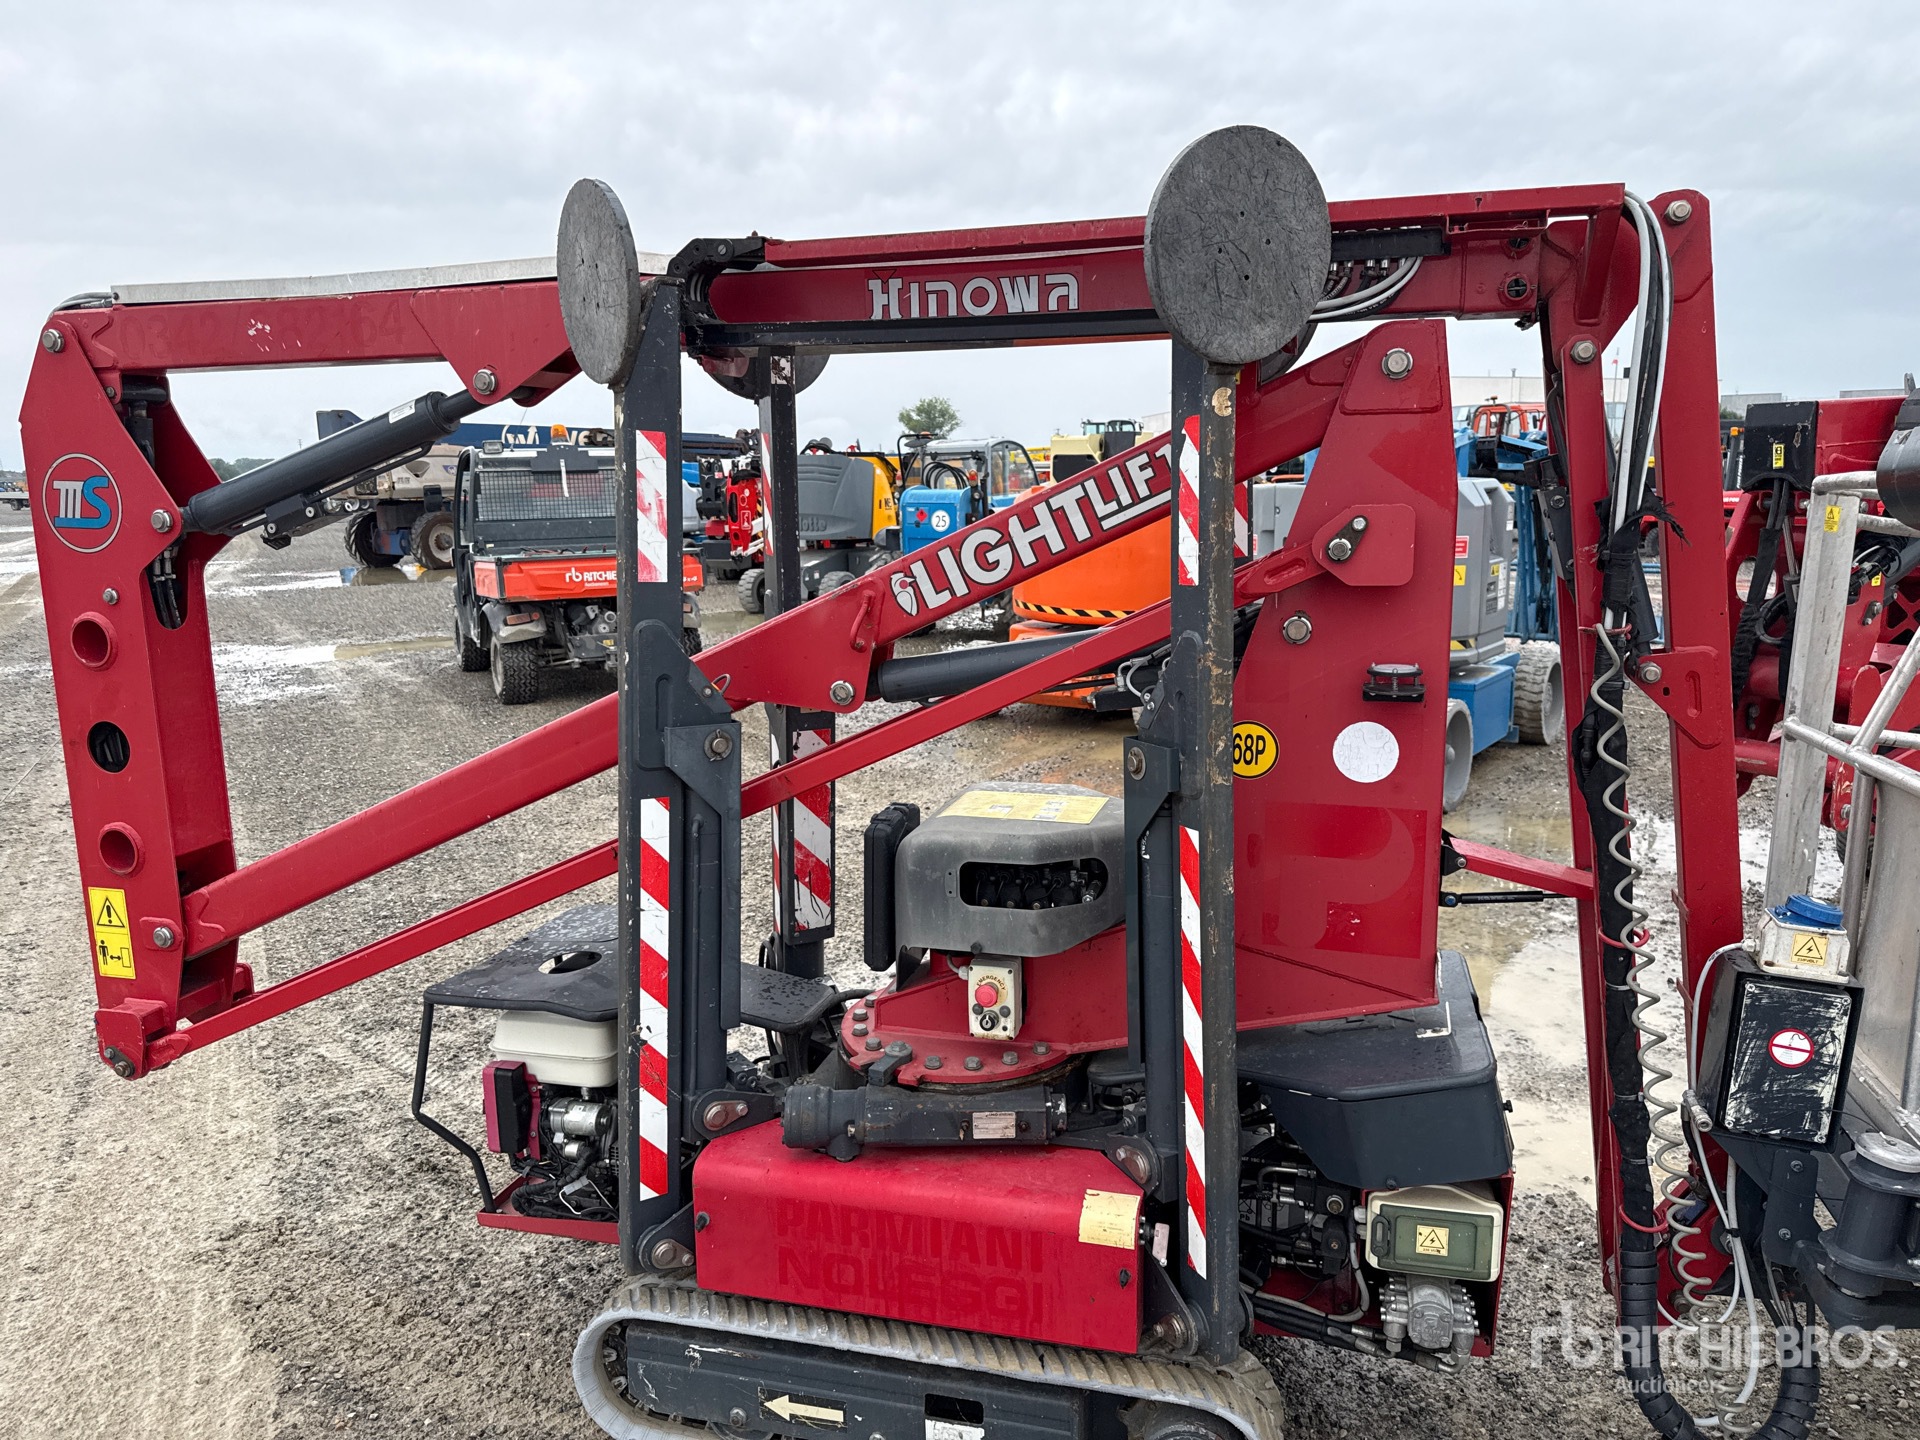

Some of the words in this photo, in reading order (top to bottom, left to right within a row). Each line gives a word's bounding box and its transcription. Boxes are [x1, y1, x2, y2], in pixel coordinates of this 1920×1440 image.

[935, 515, 947, 528] 25
[583, 570, 617, 582] RITCHIE
[1232, 732, 1267, 766] 68P
[976, 974, 1006, 991] EMERGENCY
